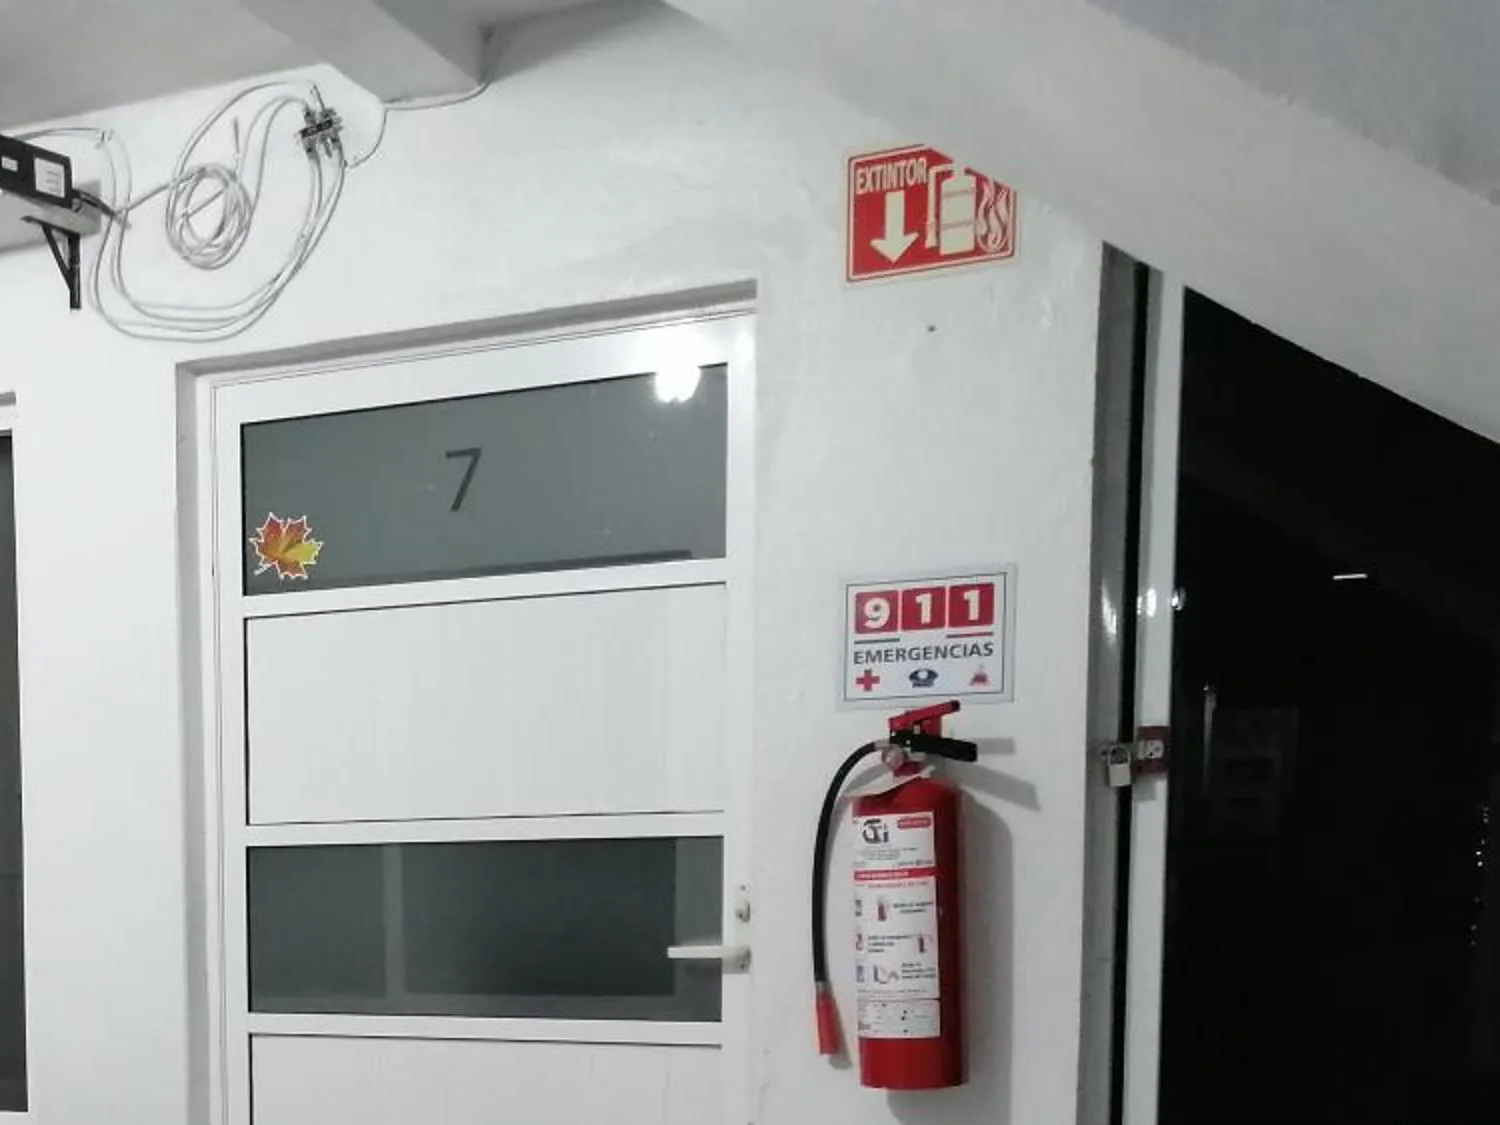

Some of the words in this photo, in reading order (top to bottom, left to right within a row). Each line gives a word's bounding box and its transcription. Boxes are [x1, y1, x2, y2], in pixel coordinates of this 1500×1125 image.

[856, 158, 929, 194] EXTINTOR
[445, 447, 483, 512] 7
[862, 589, 980, 628] 911
[853, 641, 994, 665] EMERGENCIAS
